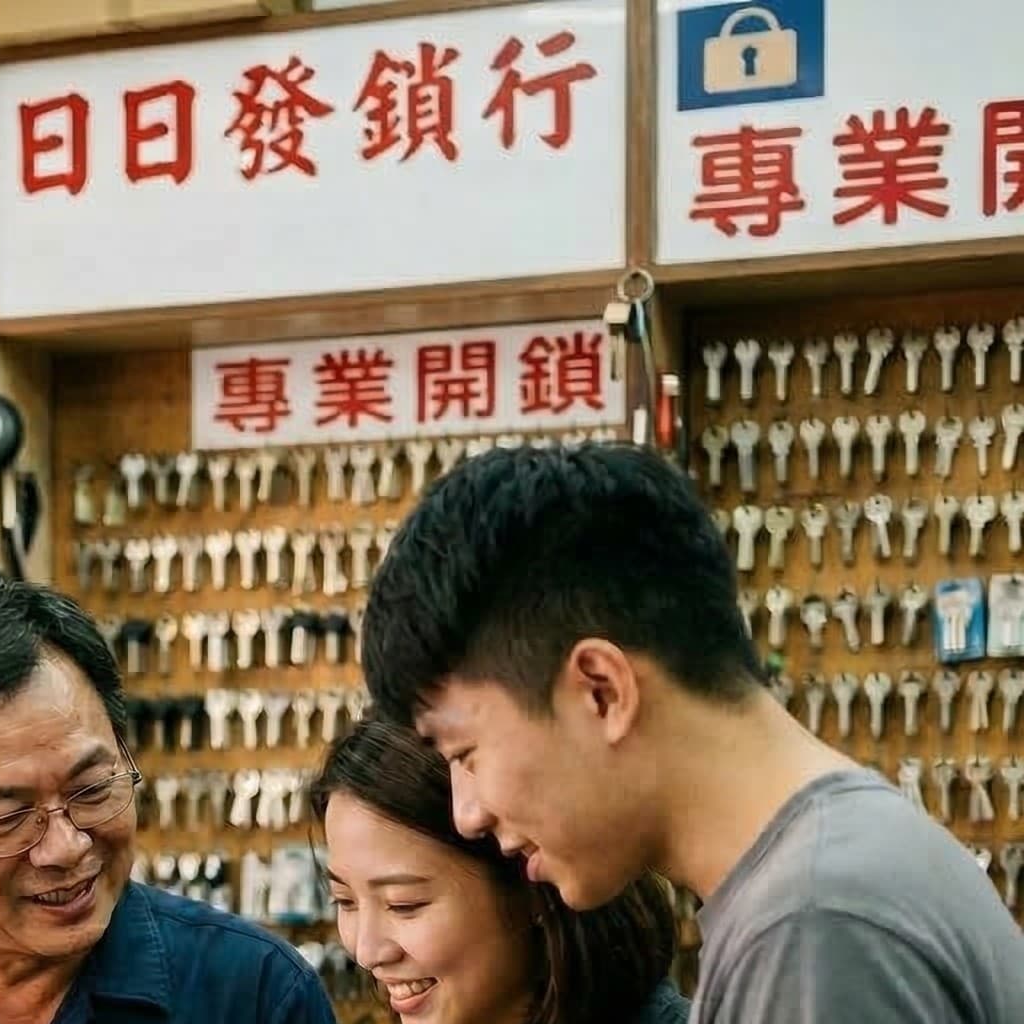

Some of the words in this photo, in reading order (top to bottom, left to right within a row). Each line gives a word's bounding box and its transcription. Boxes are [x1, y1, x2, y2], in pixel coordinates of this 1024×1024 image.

[19, 31, 597, 196] 日日發鎖行
[214, 331, 606, 433] 專業開鎖
